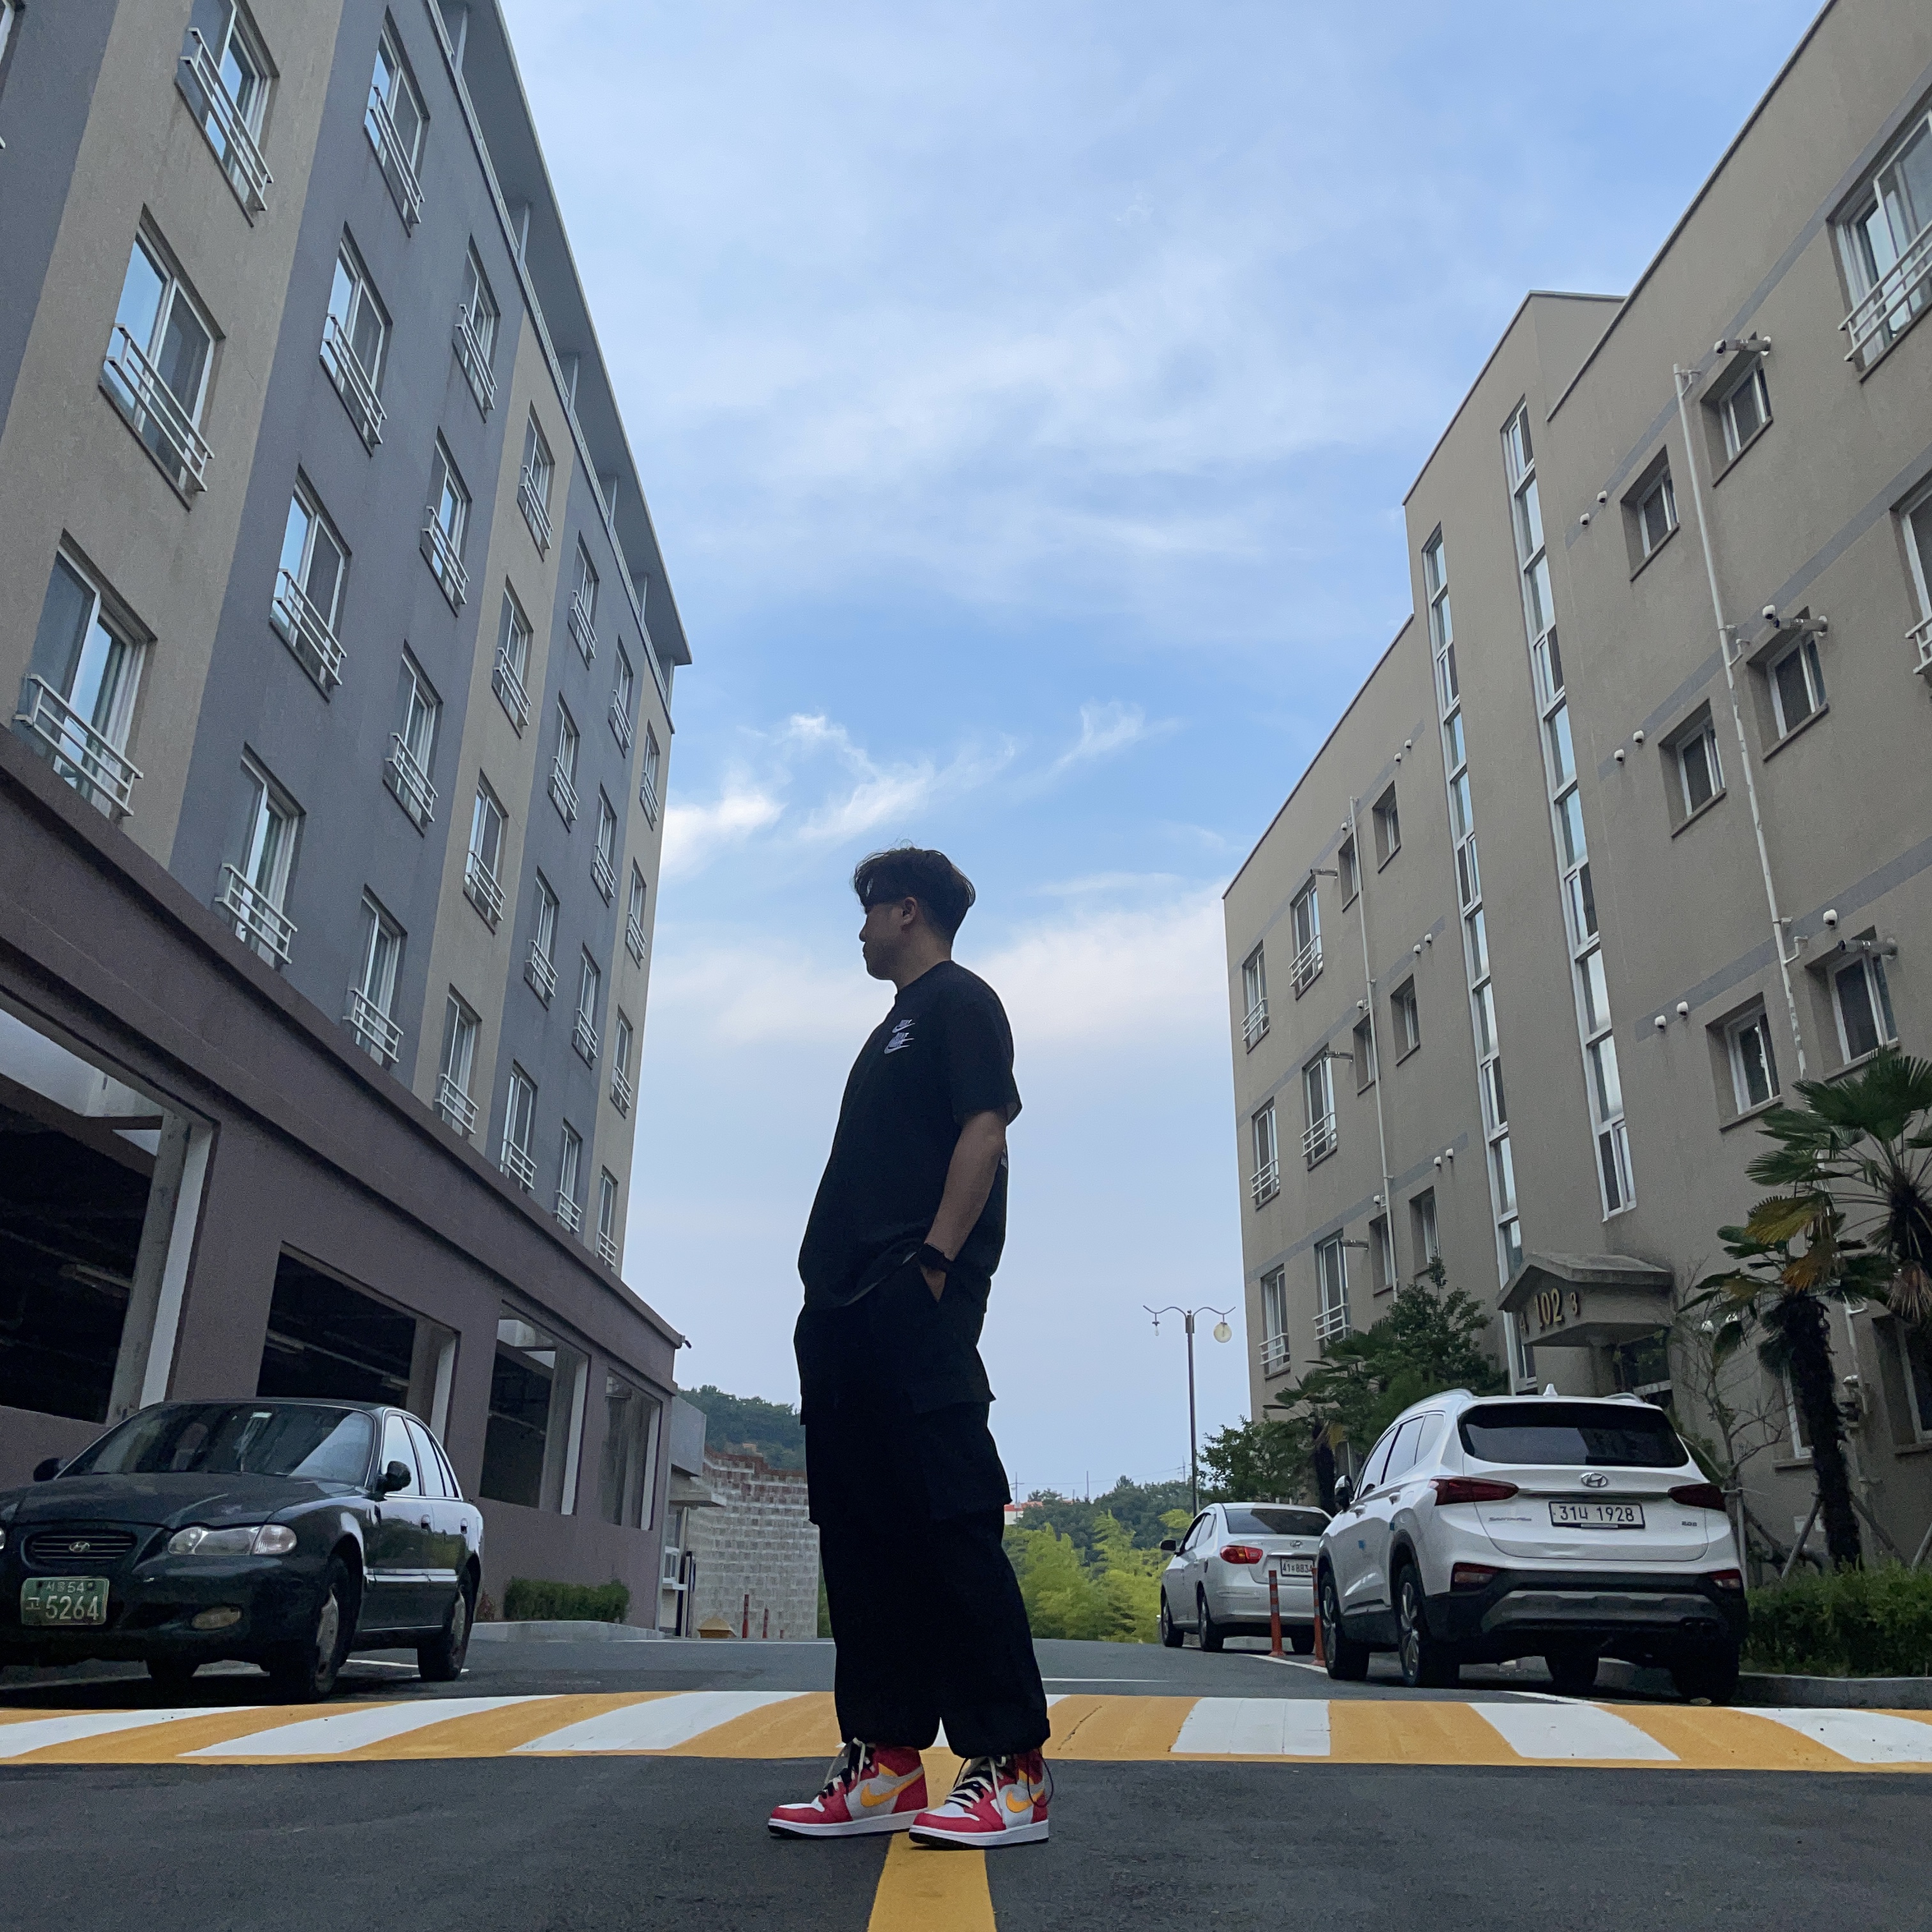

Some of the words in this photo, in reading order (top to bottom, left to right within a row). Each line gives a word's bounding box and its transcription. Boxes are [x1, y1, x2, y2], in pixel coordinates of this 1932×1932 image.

[1533, 1288, 1562, 1327] 102
[1597, 1506, 1634, 1522] 1928
[45, 1595, 99, 1620] 5264
